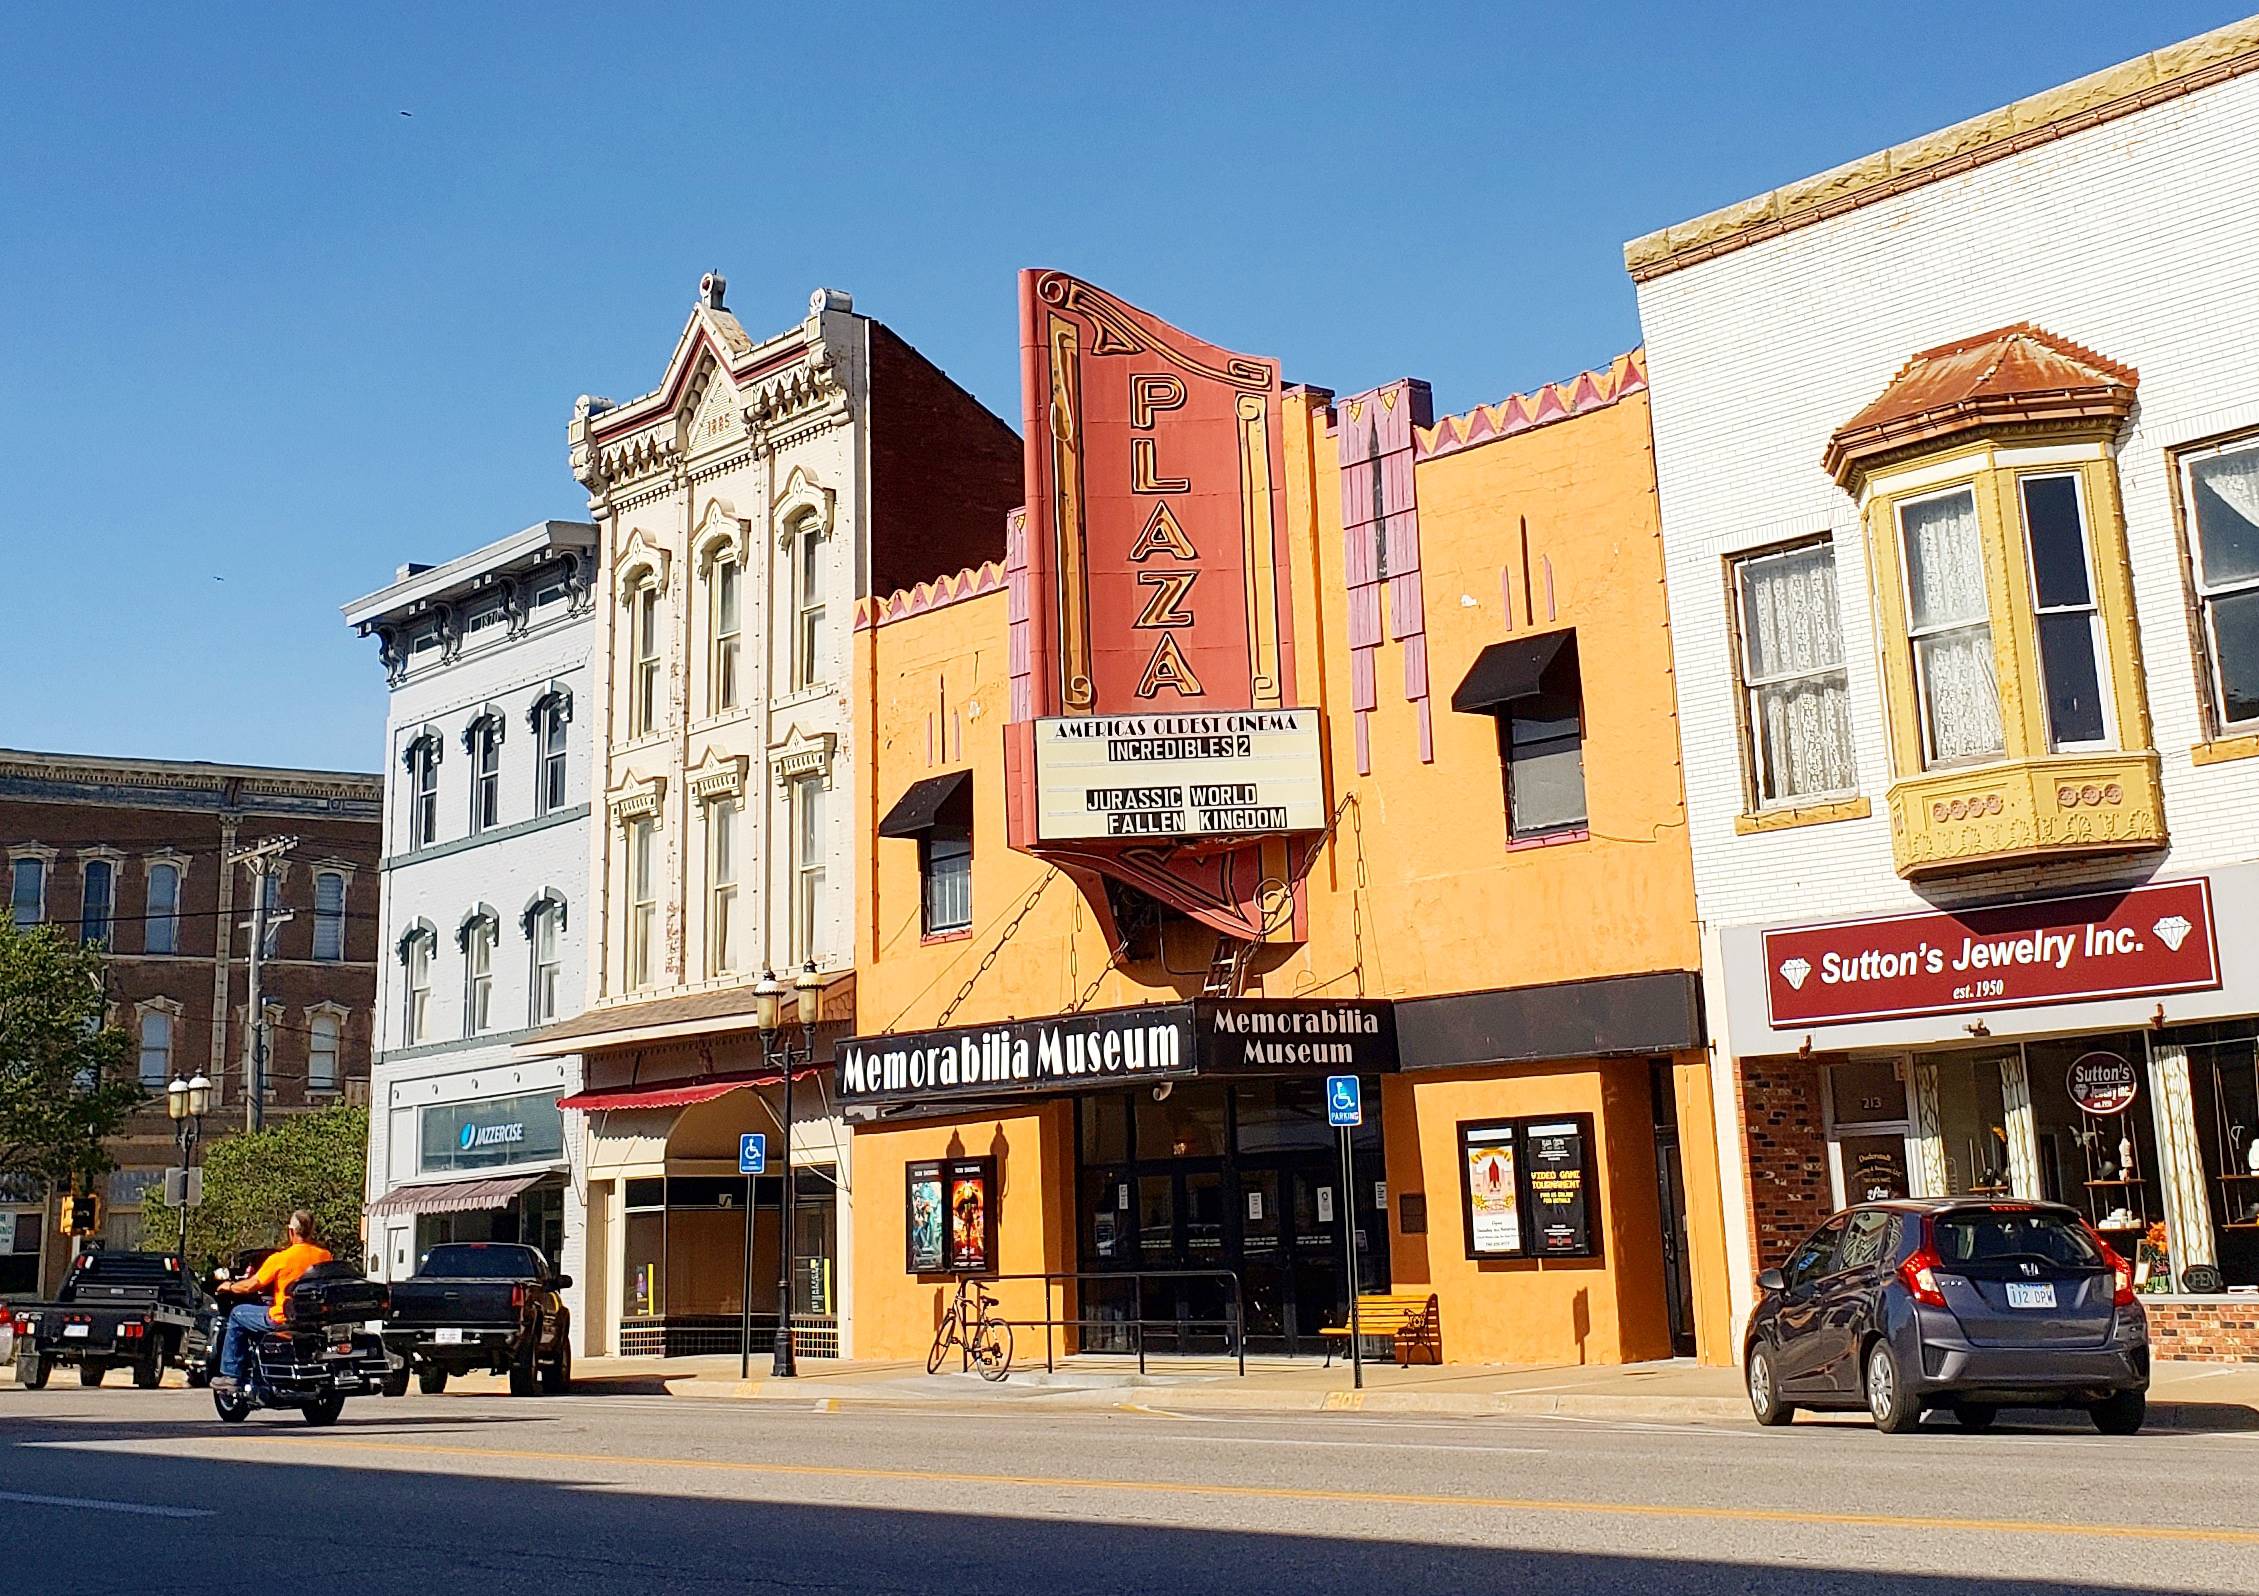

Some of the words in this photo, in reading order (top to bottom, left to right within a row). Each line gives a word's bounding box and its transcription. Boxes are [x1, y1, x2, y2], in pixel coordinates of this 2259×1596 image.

[1128, 372, 1206, 698] PLAZA
[1056, 719, 1146, 738] AMERICAS
[1153, 717, 1221, 735] OLDEST
[1227, 714, 1298, 734] CINEMA
[1110, 738, 1233, 761] INCREDIBLES
[1238, 736, 1250, 757] 2
[1087, 788, 1182, 811] JURASSIC
[1190, 785, 1257, 806] WORLD
[1108, 811, 1185, 834] FALLEN
[1199, 808, 1286, 831] KINGDOM
[1821, 941, 1944, 984] Sutton's
[1952, 929, 2075, 972] Jewelry
[2084, 922, 2145, 958] Inc.
[1214, 1008, 1379, 1035] Memorabilia
[843, 1035, 1029, 1094] Memorabilia
[1036, 1021, 1180, 1078] Museum
[1243, 1039, 1354, 1064] Museum
[2075, 1063, 2130, 1083] Sutton's
[1862, 1097, 1882, 1109] 213
[1331, 1111, 1359, 1121] PARKING
[475, 1123, 523, 1146] JAZZERCISE
